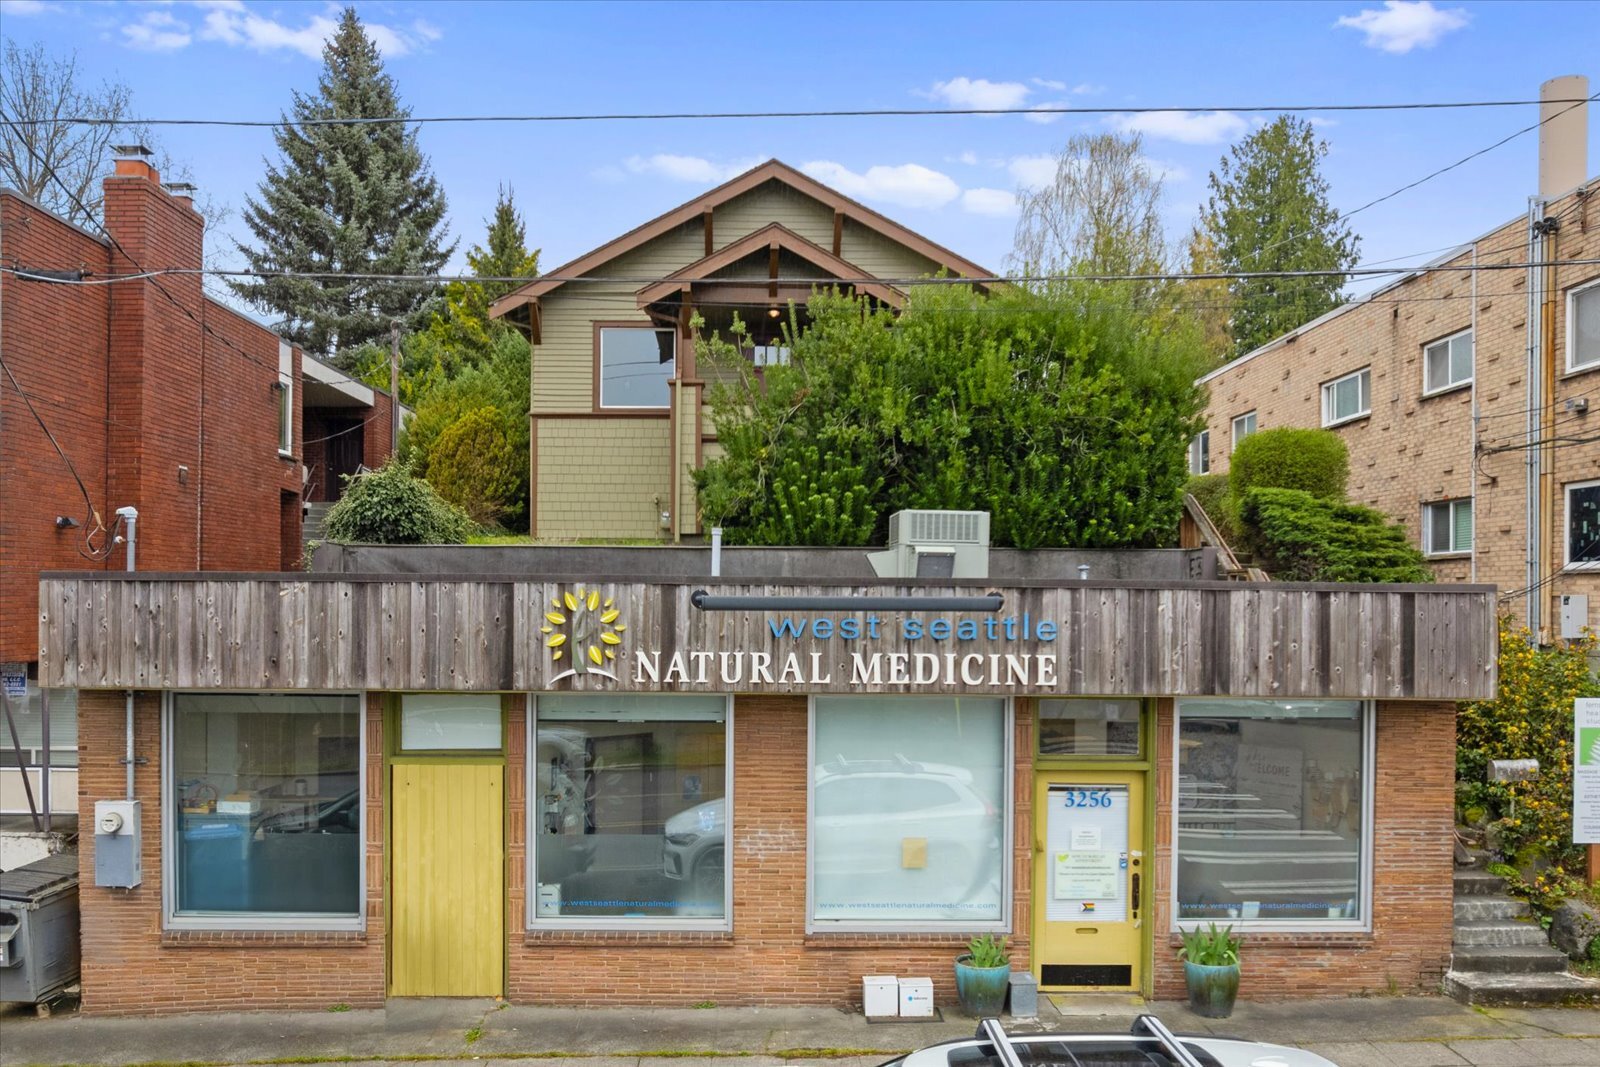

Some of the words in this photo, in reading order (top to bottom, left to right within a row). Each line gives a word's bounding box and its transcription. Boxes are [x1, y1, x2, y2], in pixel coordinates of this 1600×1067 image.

[768, 614, 880, 640] west
[903, 611, 1058, 642] seattle
[634, 650, 832, 684] NATURAL
[850, 652, 1058, 687] MEDICINE
[1064, 788, 1112, 809] 3256
